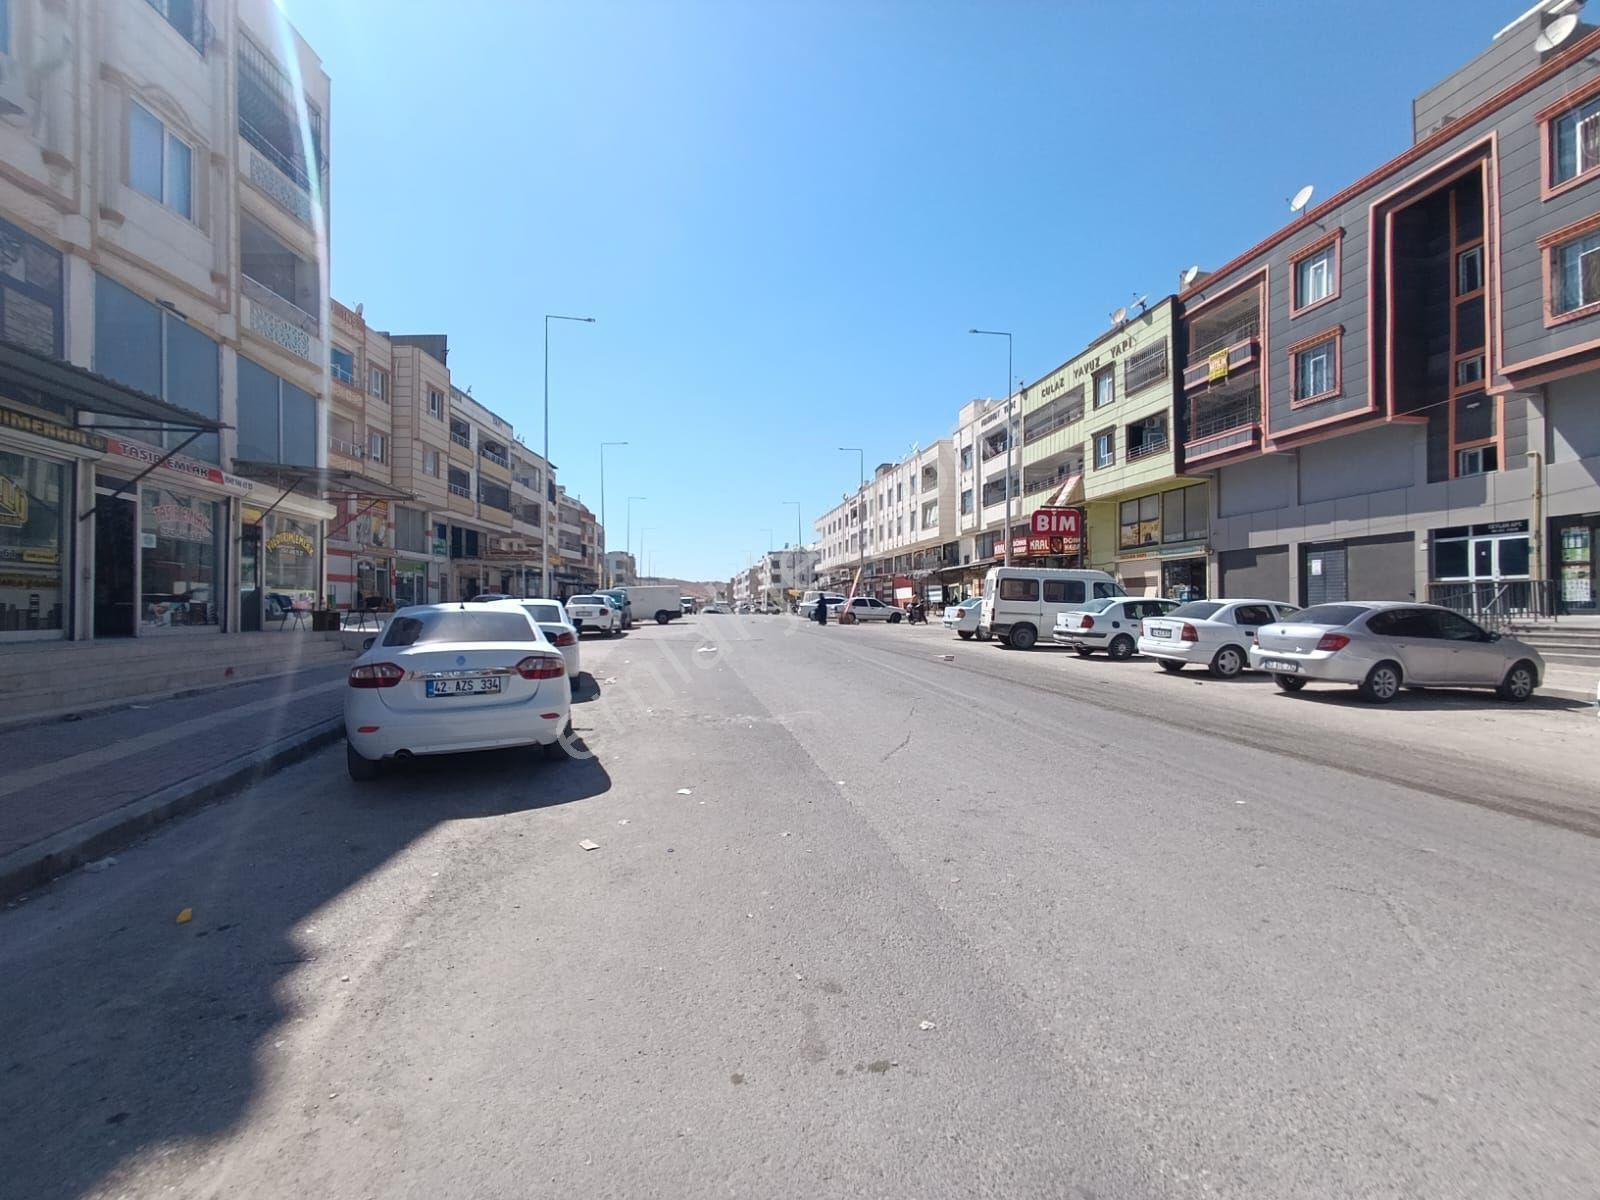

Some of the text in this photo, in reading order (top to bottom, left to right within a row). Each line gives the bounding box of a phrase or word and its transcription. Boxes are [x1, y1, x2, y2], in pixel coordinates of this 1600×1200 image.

[1073, 357, 1100, 378] YAVUZ
[167, 457, 209, 478] EMLAK
[1036, 511, 1076, 532] BİM
[1029, 539, 1050, 550] KRAL
[434, 679, 498, 693] 42 AZS 334
